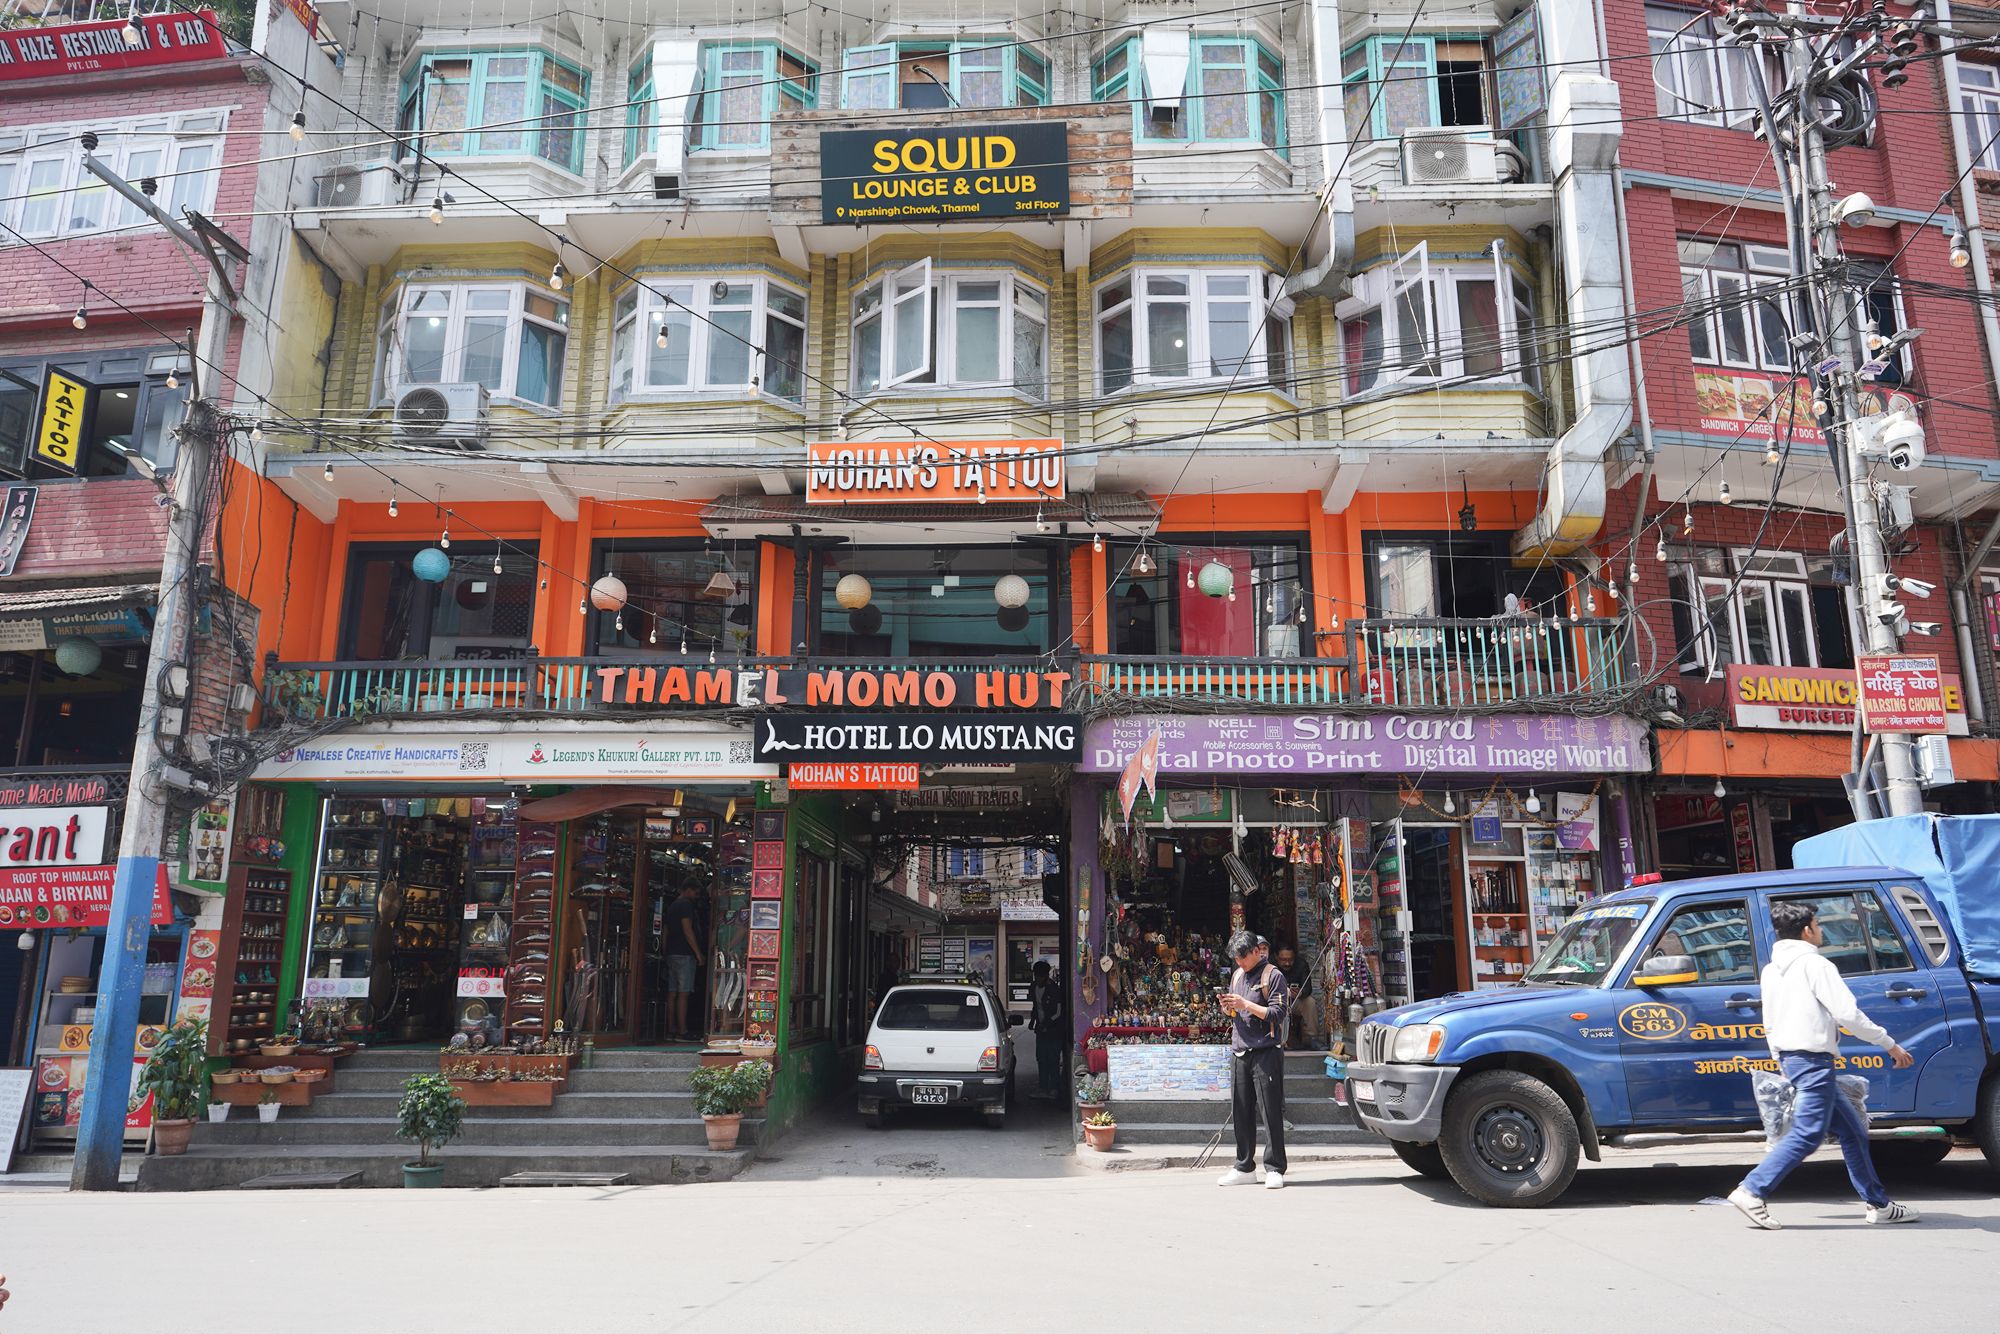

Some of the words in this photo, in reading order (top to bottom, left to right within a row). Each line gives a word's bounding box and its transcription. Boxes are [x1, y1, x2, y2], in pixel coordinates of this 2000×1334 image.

[16, 36, 58, 62] HAZE
[157, 23, 171, 48] &
[174, 20, 208, 46] BAR
[67, 61, 84, 71] PVT.
[85, 59, 102, 70] LTD.
[872, 135, 1016, 173] SQUID
[853, 178, 949, 200] LOUNGE
[953, 179, 971, 196] &
[975, 175, 1037, 195] CLUB
[849, 205, 901, 218] Narshingh
[902, 204, 940, 216] Chowk,
[942, 203, 980, 213] Thamel
[1015, 200, 1032, 210] 3rd
[1034, 199, 1060, 209] Floor
[48, 381, 77, 458] TATTOO
[1700, 418, 1739, 432] SANDWICH
[1799, 428, 1814, 439] DOG
[811, 448, 938, 491] MOHAN'S
[949, 446, 1061, 489] TATTOO
[597, 667, 788, 708] THAMEL
[807, 670, 957, 708] MOMO
[975, 671, 1072, 709] HUT
[1907, 670, 1938, 690] चोक
[1866, 697, 1907, 713] NARSING
[1908, 697, 1942, 712] CHOWK
[1113, 718, 1142, 728] Visa
[1146, 717, 1186, 728] Photo
[1208, 718, 1257, 729] NCELL
[1779, 707, 1856, 724] BURGER
[1112, 728, 1143, 739] Post
[1220, 729, 1249, 739] NTC
[1293, 715, 1375, 741] Sim
[1385, 715, 1476, 742] Card
[804, 724, 893, 750] HOTEL
[898, 724, 934, 749] LO
[940, 723, 1076, 751] MUSTANG
[1112, 738, 1166, 749] Posts
[1203, 741, 1227, 750] Mobile
[1228, 740, 1274, 750] Accessories
[1275, 741, 1283, 750] &
[1284, 741, 1323, 751] Souvenirs
[296, 747, 343, 761] NEPALESE
[346, 747, 392, 761] CREATIVE
[394, 747, 458, 761] HANDICRAFTS
[553, 748, 595, 762] LEGEND'S
[598, 748, 639, 762] KHUKURI
[641, 748, 682, 762] GALLERY
[684, 751, 702, 763] PVT.
[704, 751, 724, 763] LTD.
[1095, 749, 1198, 769] Dital
[1207, 749, 1294, 769] Photo
[1306, 749, 1382, 769] Print
[1404, 744, 1478, 770] Digital
[1486, 744, 1557, 770] Image
[1562, 744, 1630, 768] World
[790, 765, 859, 783] MOHAN'S
[863, 765, 918, 783] TATTOO
[27, 783, 63, 804] Made
[65, 781, 105, 803] MoMo
[977, 789, 1019, 807] TRAVELS
[12, 871, 37, 884] ROOF
[40, 871, 59, 883] TOP
[62, 870, 110, 882] HIMALAYA
[37, 887, 48, 903] &
[52, 885, 108, 902] BIRYANI
[1593, 907, 1639, 918] POLICE
[1631, 1008, 1668, 1019] CM
[1632, 1019, 1676, 1032] 563
[1851, 1056, 1884, 1069] १००
